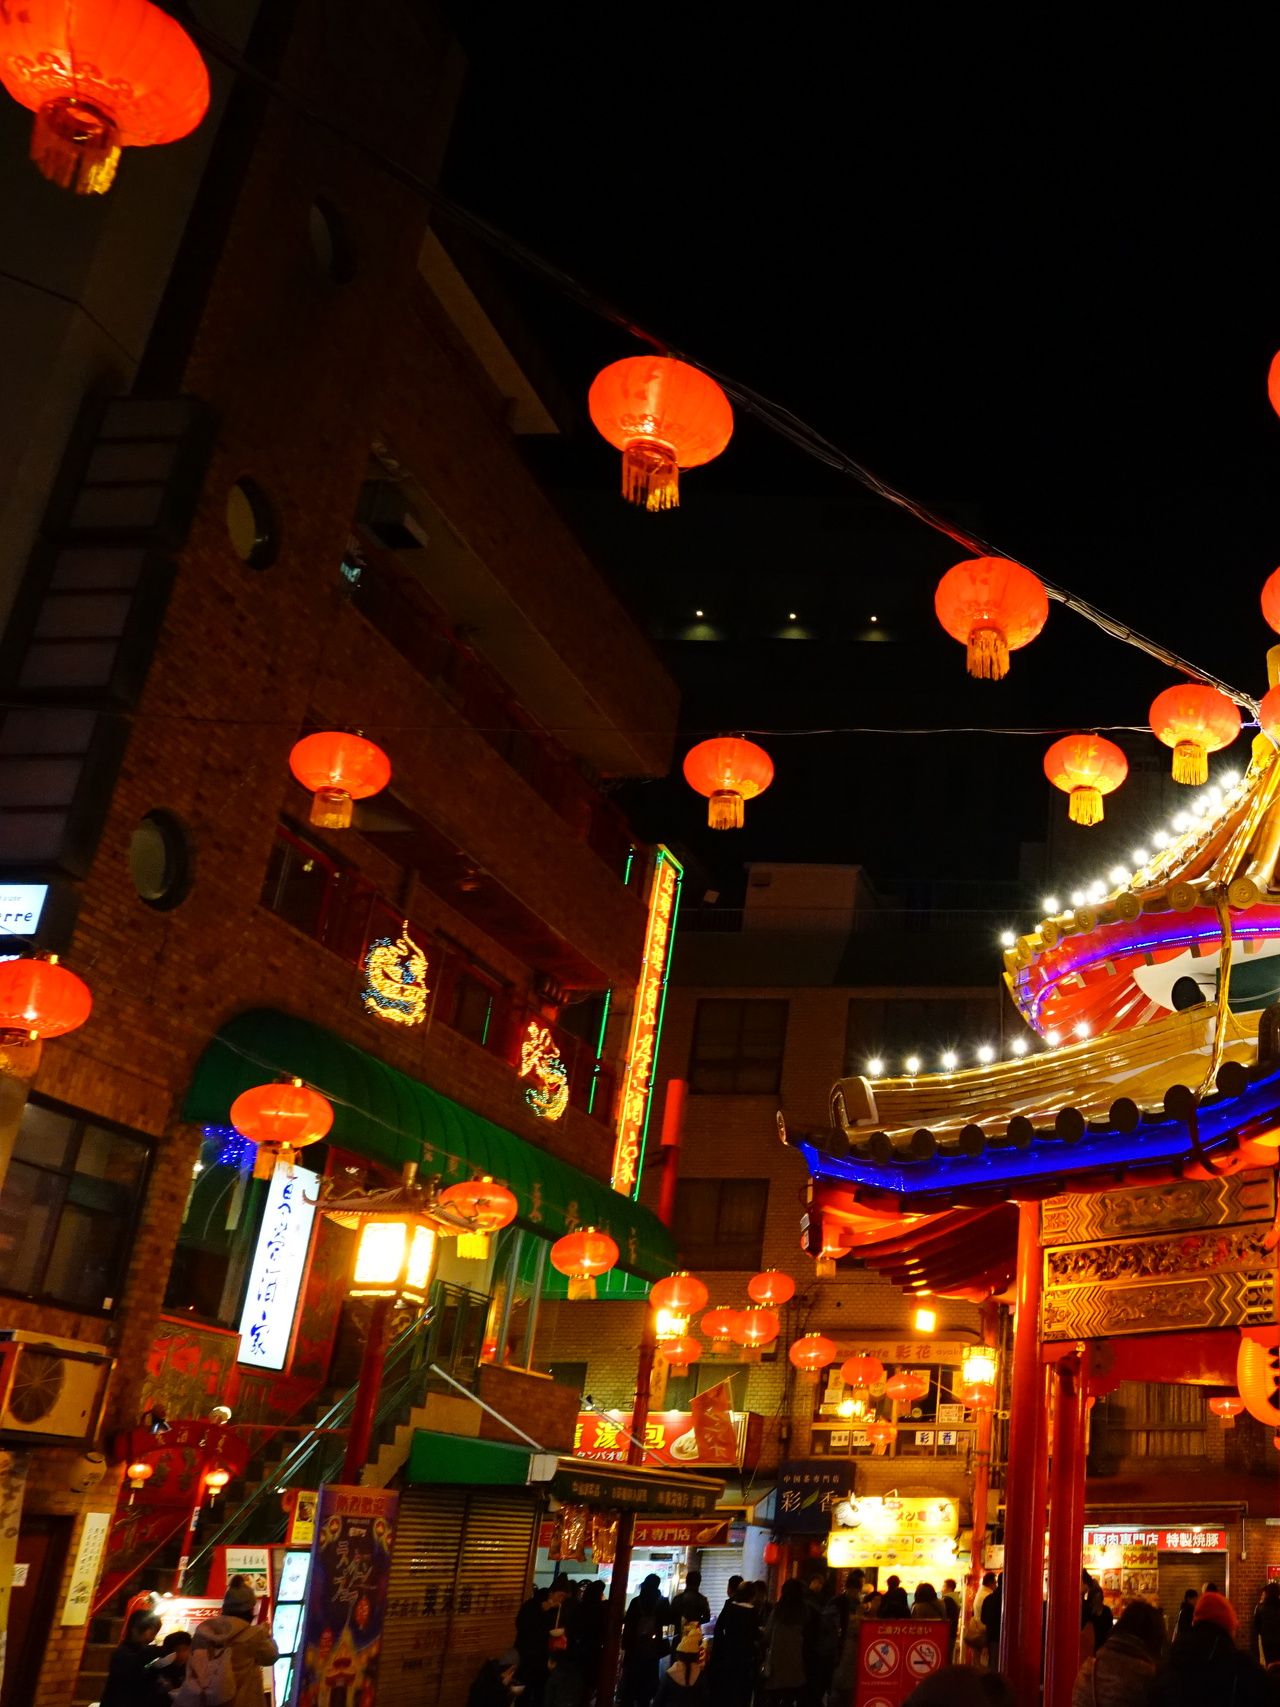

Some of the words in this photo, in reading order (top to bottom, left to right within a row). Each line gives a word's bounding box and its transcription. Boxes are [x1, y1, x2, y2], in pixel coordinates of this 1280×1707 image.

[0, 912, 33, 922] rre
[896, 1344, 931, 1360] 彩花
[574, 1421, 665, 1449] 湯包
[919, 1432, 932, 1444] 彩
[943, 1432, 955, 1445] 香
[1166, 1533, 1219, 1547] 特製焼豚
